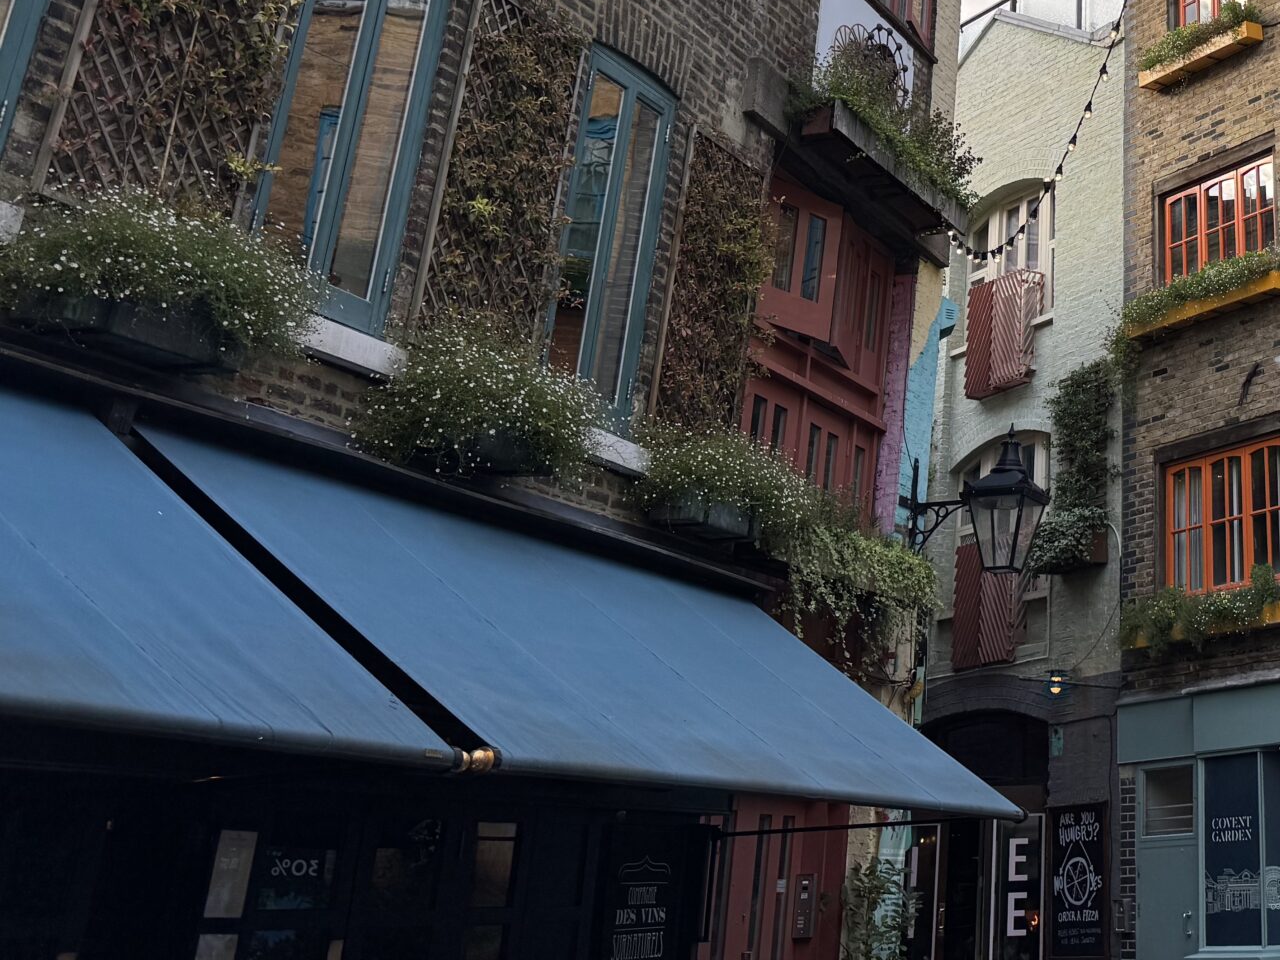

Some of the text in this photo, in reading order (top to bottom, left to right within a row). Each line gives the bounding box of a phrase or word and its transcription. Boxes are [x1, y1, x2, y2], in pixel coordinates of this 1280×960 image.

[1060, 810, 1095, 827] ARE YOU
[1212, 815, 1252, 829] COVENT
[1059, 822, 1100, 847] HUNGRY?
[1212, 828, 1252, 842] GARDEN
[615, 907, 666, 925] DES VINS
[1082, 909, 1099, 921] PIZZA
